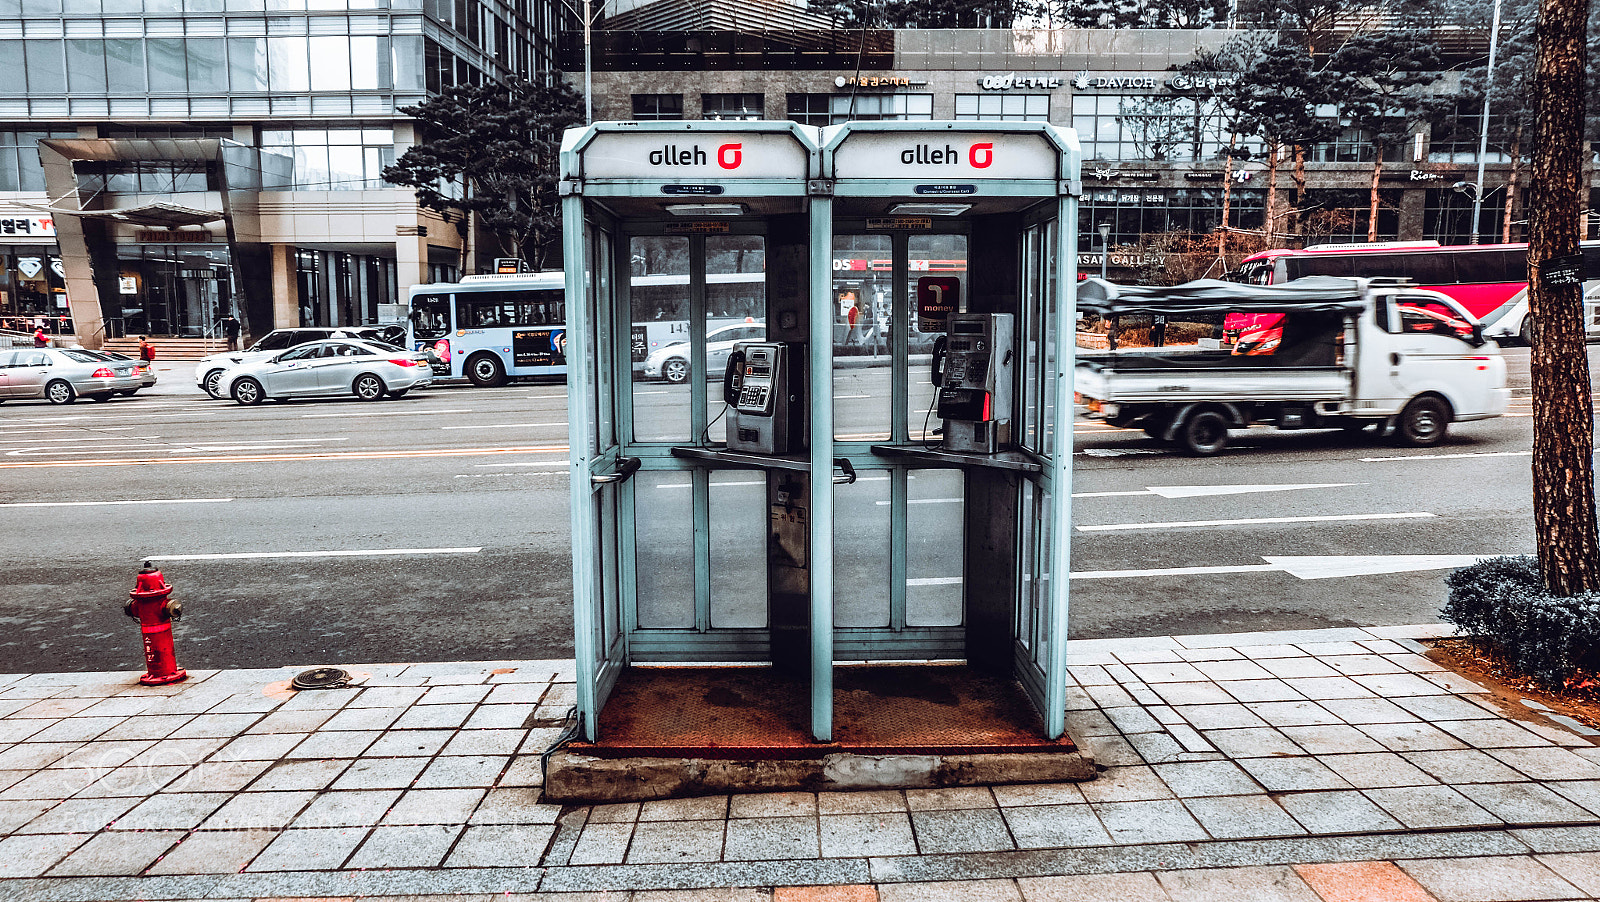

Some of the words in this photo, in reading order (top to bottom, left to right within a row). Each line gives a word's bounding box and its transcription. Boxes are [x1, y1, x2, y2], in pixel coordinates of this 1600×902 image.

[1096, 76, 1155, 88] DAVICH
[649, 145, 707, 166] olleh
[900, 144, 958, 165] olleh
[924, 305, 954, 313] money
